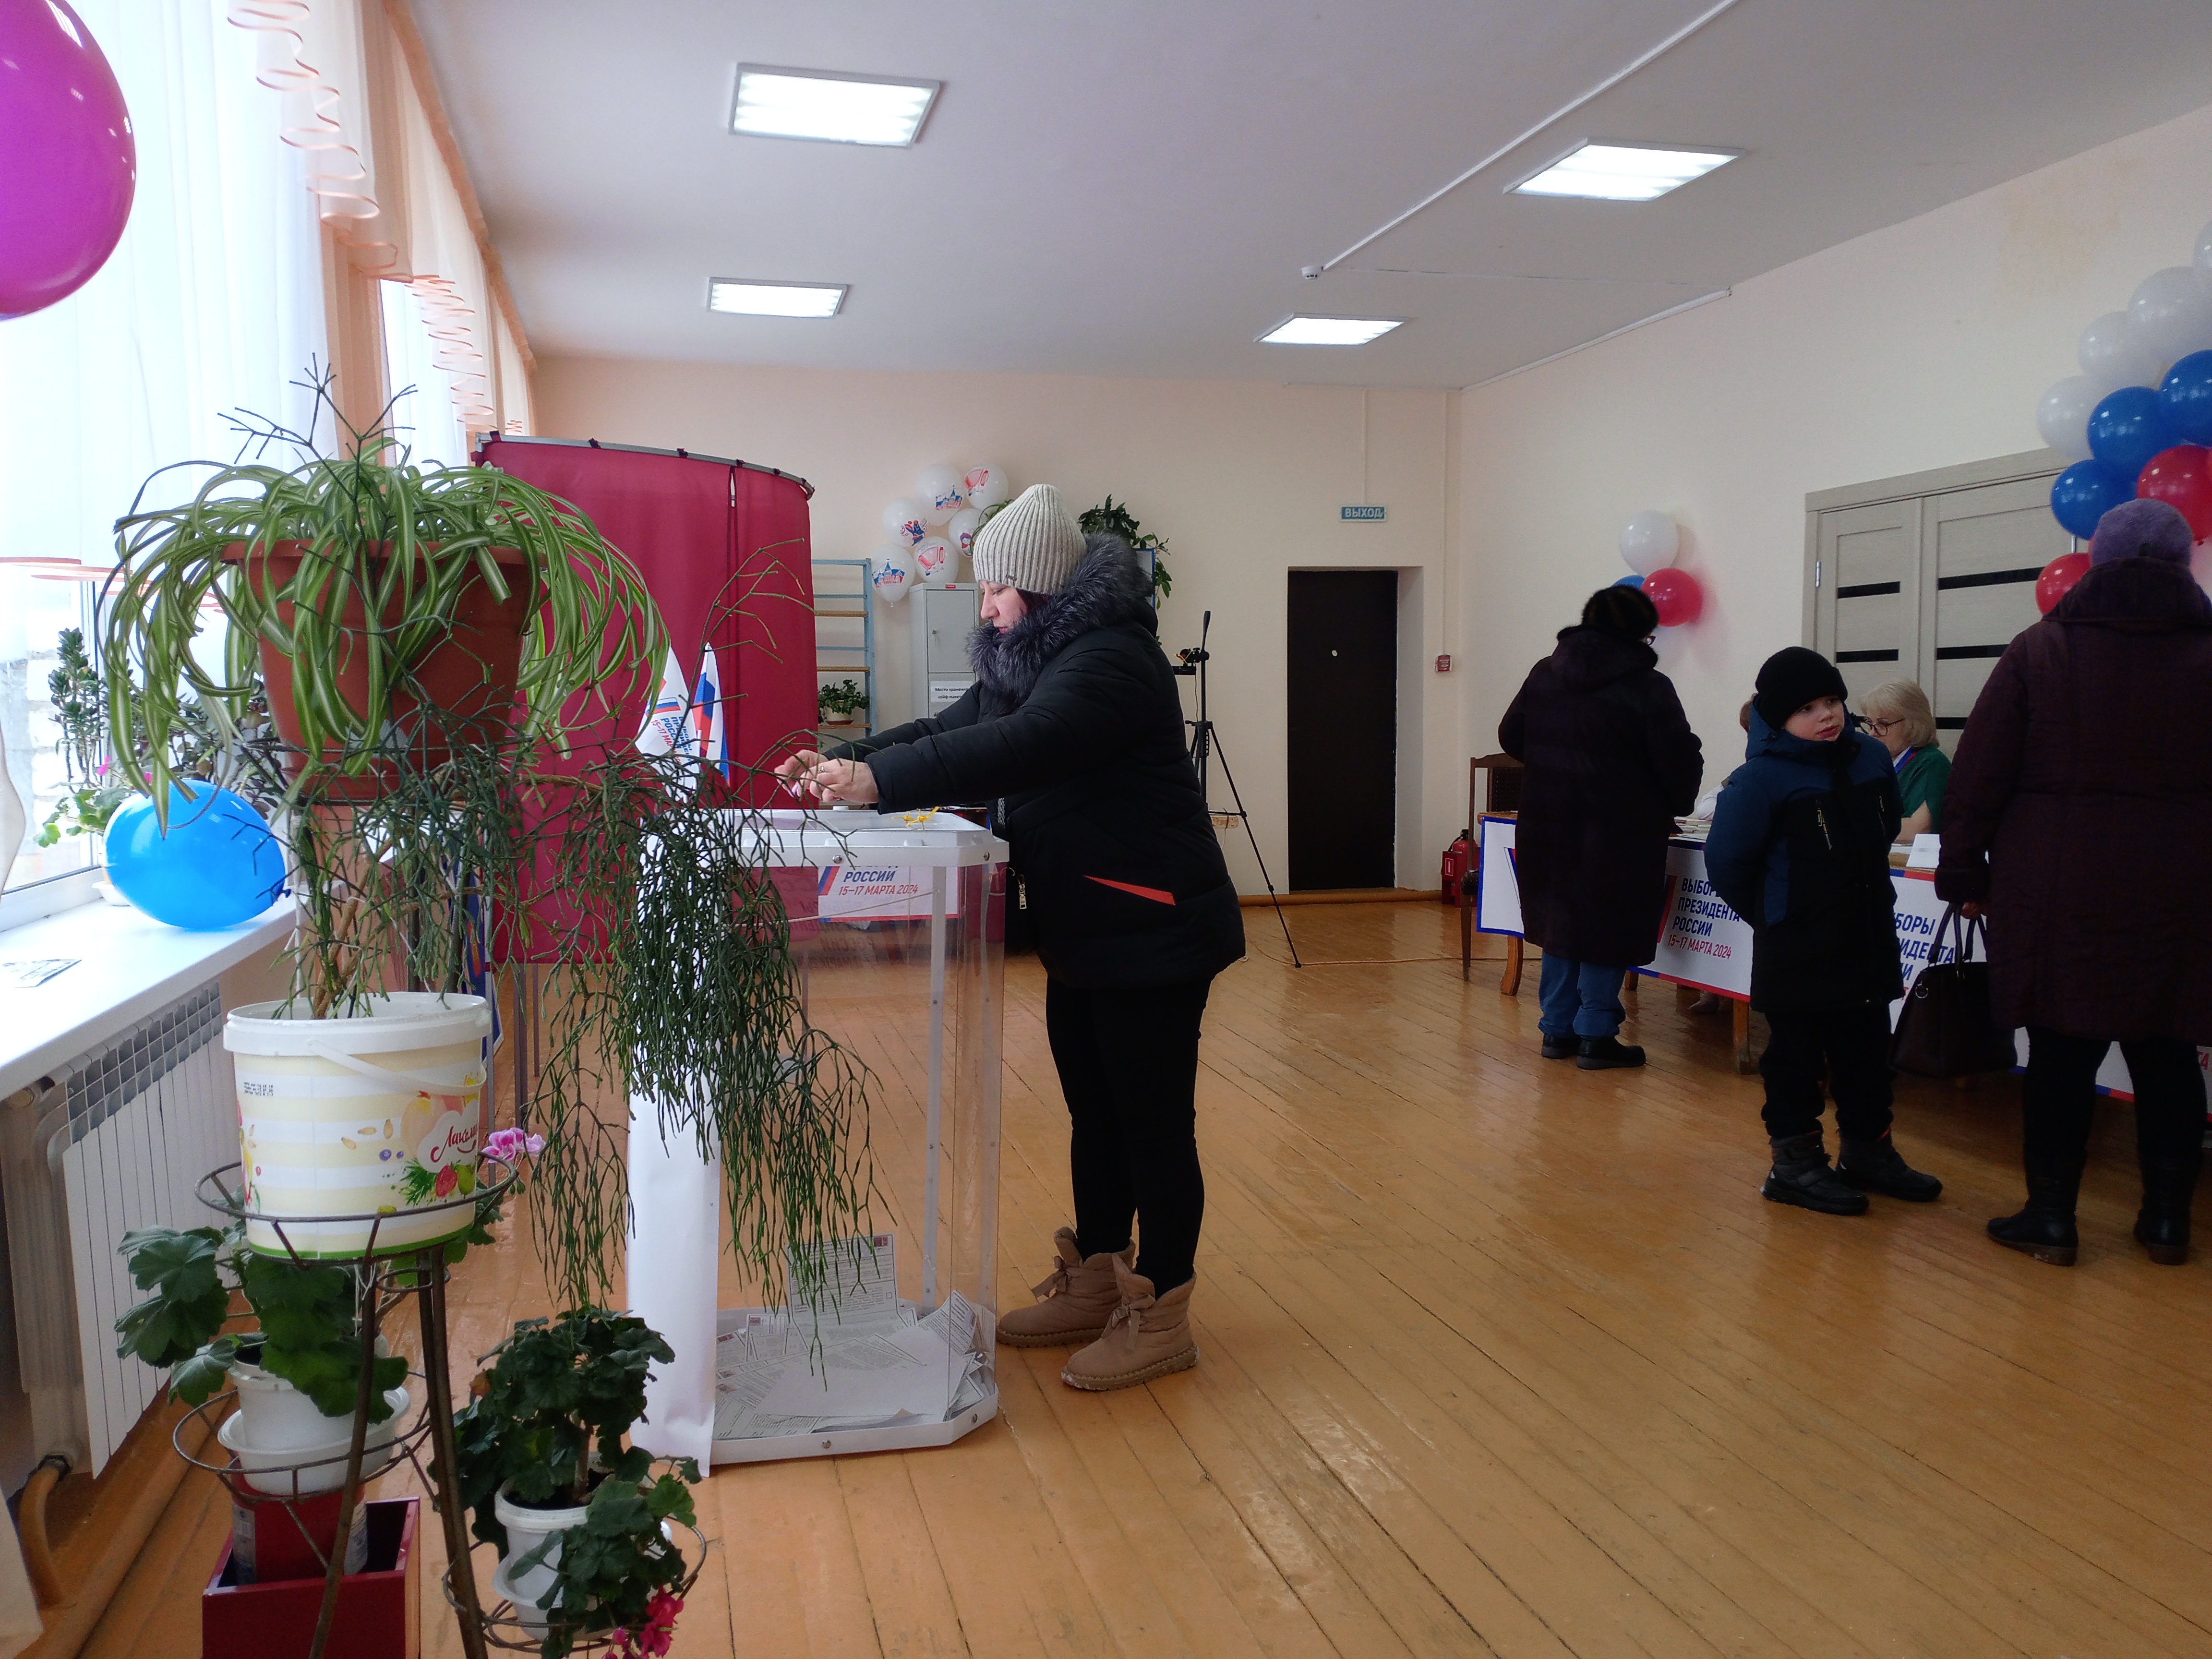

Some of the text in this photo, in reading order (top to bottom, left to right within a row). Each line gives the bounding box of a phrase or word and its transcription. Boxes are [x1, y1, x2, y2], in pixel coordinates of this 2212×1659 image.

[1345, 507, 1383, 518] ВЫХОД
[843, 870, 896, 882] РОССИИ
[865, 885, 895, 895] МАРТА
[897, 885, 918, 894] 2024
[1681, 878, 1720, 898] ВЫБО
[1672, 915, 1713, 937] РОССИИ
[1894, 913, 1936, 935] БОРЫ
[1688, 939, 1712, 955] МАРТА
[1713, 944, 1732, 959] 2024
